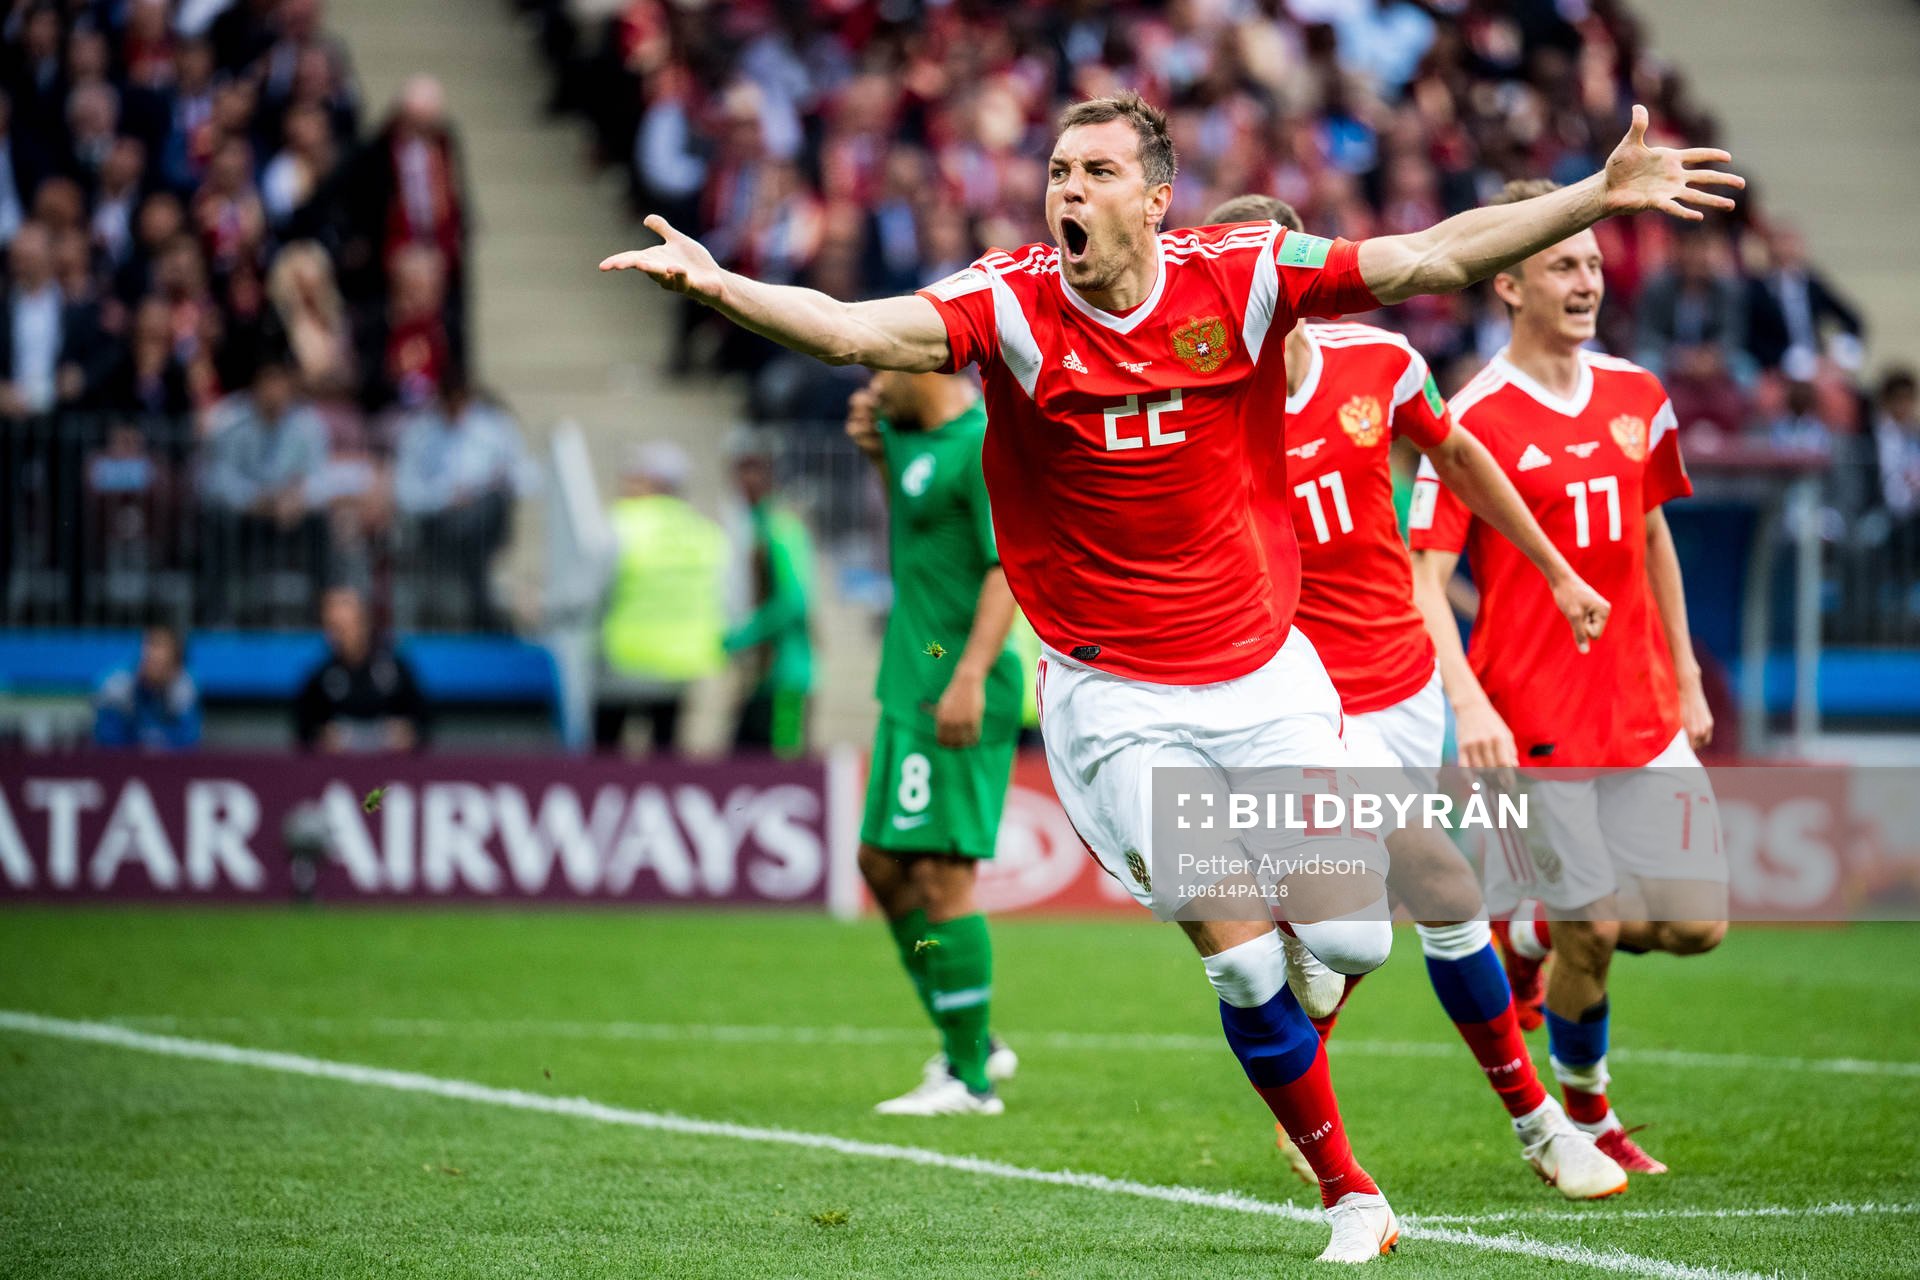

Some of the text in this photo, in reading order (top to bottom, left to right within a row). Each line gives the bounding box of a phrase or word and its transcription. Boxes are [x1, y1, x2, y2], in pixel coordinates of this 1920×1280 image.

[1103, 387, 1187, 452] 22
[1294, 470, 1354, 545] 11
[1566, 475, 1621, 548] 17
[897, 753, 931, 813] 8
